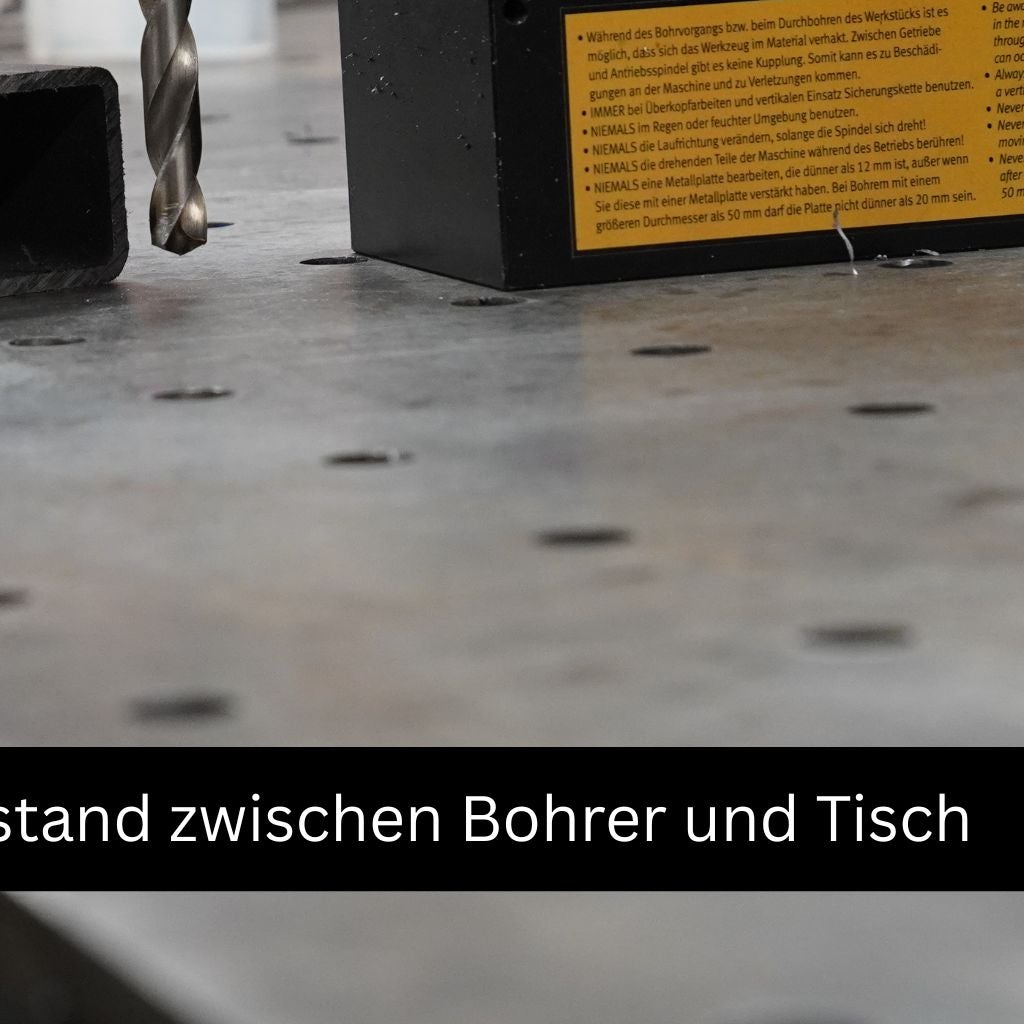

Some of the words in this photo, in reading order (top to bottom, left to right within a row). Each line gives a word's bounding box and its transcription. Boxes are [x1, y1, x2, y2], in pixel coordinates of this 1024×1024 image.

[992, 1, 1004, 13] Be
[993, 19, 1002, 29] in
[1004, 17, 1019, 29] the
[586, 29, 631, 42] Während
[634, 29, 652, 39] des
[654, 24, 723, 38] Bohrvorgangs
[725, 21, 748, 32] bzw.
[751, 18, 775, 31] beim
[778, 14, 842, 28] Durchbohren
[844, 12, 862, 23] des
[864, 7, 920, 24] Werkstücks
[923, 7, 934, 18] ist
[936, 7, 948, 17] es
[587, 48, 630, 63] möglich,
[658, 44, 677, 56] sich
[680, 43, 698, 54] das
[700, 40, 749, 53] Werkzeug
[751, 38, 763, 49] im
[766, 34, 806, 48] Material
[808, 32, 848, 45] verhakt.
[850, 29, 896, 42] Zwischen
[898, 25, 941, 38] Getriebe
[995, 54, 1012, 63] can
[588, 69, 607, 80] und
[610, 62, 688, 78] Antriebsspindel
[690, 61, 710, 75] gibt
[712, 62, 724, 71] es
[726, 58, 753, 70] keine
[755, 55, 805, 69] Kupplung.
[807, 51, 836, 64] Somit
[838, 50, 863, 61] kann
[865, 50, 877, 59] es
[879, 50, 891, 58] zu
[893, 43, 941, 57] Beschädi-
[589, 88, 626, 102] gungen
[629, 87, 641, 96] an
[644, 83, 660, 95] der
[662, 80, 710, 93] Maschine
[712, 78, 732, 90] und
[735, 79, 746, 88] zu
[748, 74, 812, 86] Verletzungen
[814, 70, 860, 82] kommen.
[590, 104, 624, 117] IMMER
[627, 103, 642, 115] bei
[645, 98, 731, 114] Überkopfarbeiten
[734, 94, 753, 107] und
[755, 92, 804, 105] vertikalen
[806, 89, 841, 101] Einsatz
[844, 83, 922, 99] Sicherungskette
[925, 80, 973, 92] benutzen.
[996, 88, 1002, 97] a
[590, 122, 635, 136] NIEMALS
[637, 122, 649, 132] im
[652, 120, 683, 134] Regen
[685, 118, 708, 129] oder
[710, 115, 751, 127] feuchter
[753, 111, 807, 125] Umgebung
[809, 108, 858, 120] benutzen.
[592, 141, 637, 155] NIEMALS
[639, 140, 655, 152] die
[657, 137, 719, 151] Laufrichtung
[775, 129, 815, 142] solange
[816, 126, 832, 138] die
[834, 122, 872, 138] Spindel
[874, 121, 894, 133] sich
[896, 119, 925, 132] dreht!
[593, 160, 638, 174] NIEMALS
[640, 159, 656, 171] die
[658, 156, 712, 169] drehenden
[714, 152, 737, 164] Teile
[739, 151, 756, 163] der
[758, 147, 805, 161] Maschine
[807, 143, 850, 157] während
[853, 143, 871, 153] des
[873, 138, 914, 152] Betriebs
[916, 134, 963, 149] berühren!
[999, 154, 1024, 165] Neve
[594, 178, 639, 192] NIEMALS
[641, 177, 663, 189] eine
[665, 174, 724, 187] Metallplatte
[726, 168, 783, 182] bearbeiten,
[784, 166, 800, 178] die
[802, 165, 838, 176] dünner
[840, 162, 854, 173] als
[857, 160, 870, 172] 12
[873, 161, 891, 170] mm
[894, 158, 909, 169] ist,
[911, 155, 940, 168] außer
[941, 155, 968, 165] wenn
[1000, 169, 1023, 184] after
[595, 200, 610, 212] Sie
[613, 200, 640, 210] diese
[643, 197, 658, 207] mit
[661, 195, 686, 206] einer
[688, 190, 747, 204] Metallplatte
[749, 185, 792, 199] verstärkt
[794, 183, 829, 195] haben.
[831, 181, 847, 193] Bei
[891, 176, 907, 188] mit
[909, 175, 940, 186] einem
[1001, 187, 1015, 199] 50
[596, 218, 640, 233] größeren
[642, 213, 707, 227] Durchmesser
[710, 210, 725, 221] als
[727, 208, 740, 220] 50
[742, 209, 761, 218] mm
[764, 204, 784, 217] darf
[786, 204, 802, 215] die
[804, 202, 832, 213] Platte
[834, 199, 859, 211] nicht
[861, 197, 896, 209] dünner
[898, 195, 913, 206] als
[915, 193, 928, 205] 20
[930, 194, 950, 203] mm
[952, 190, 976, 202] sein.
